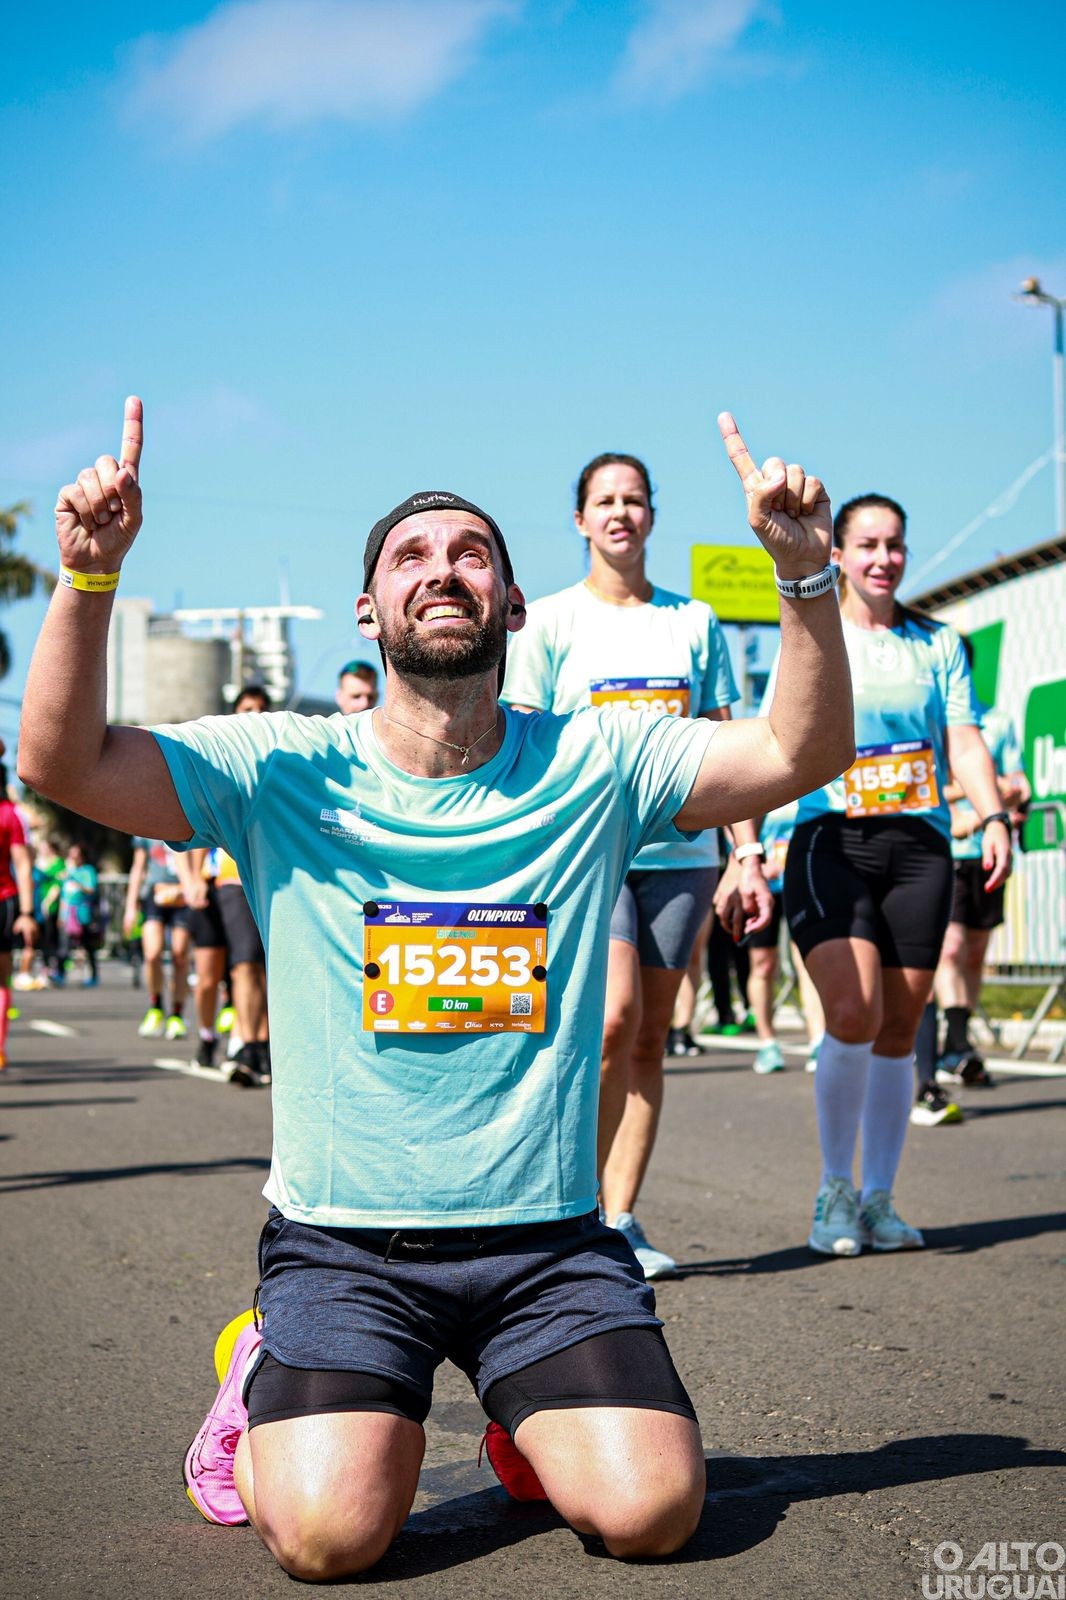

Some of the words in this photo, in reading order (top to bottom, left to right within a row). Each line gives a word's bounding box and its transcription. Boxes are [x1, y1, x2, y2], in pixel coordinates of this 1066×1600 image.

[849, 760, 928, 792] 15543
[467, 909, 527, 922] OLYMPIKUS
[377, 944, 531, 987] 15253
[377, 993, 387, 1012] E
[442, 999, 453, 1010] 10
[454, 1000, 469, 1010] km
